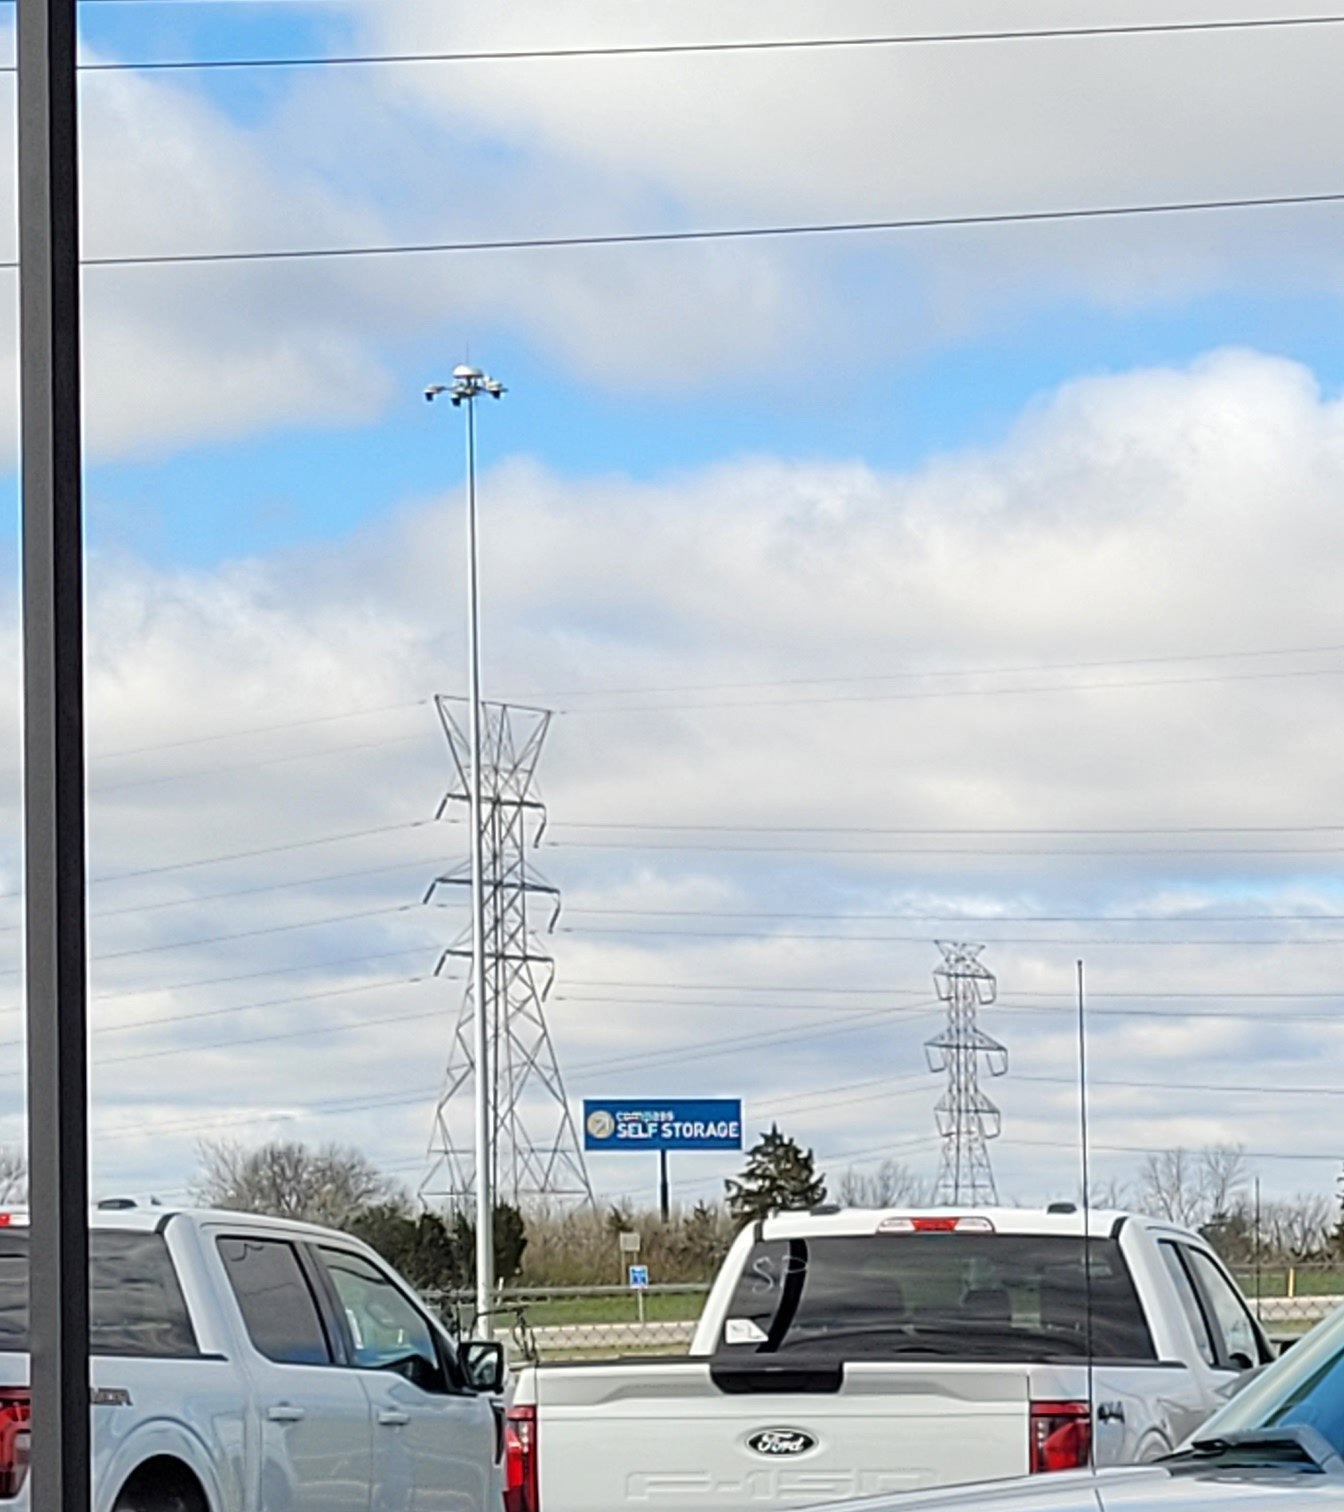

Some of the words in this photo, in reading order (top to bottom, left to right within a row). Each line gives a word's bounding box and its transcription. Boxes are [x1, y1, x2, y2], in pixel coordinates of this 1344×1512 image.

[617, 1123, 657, 1138] SELF
[661, 1121, 739, 1138] STORAGE
[757, 1431, 805, 1453] Ford
